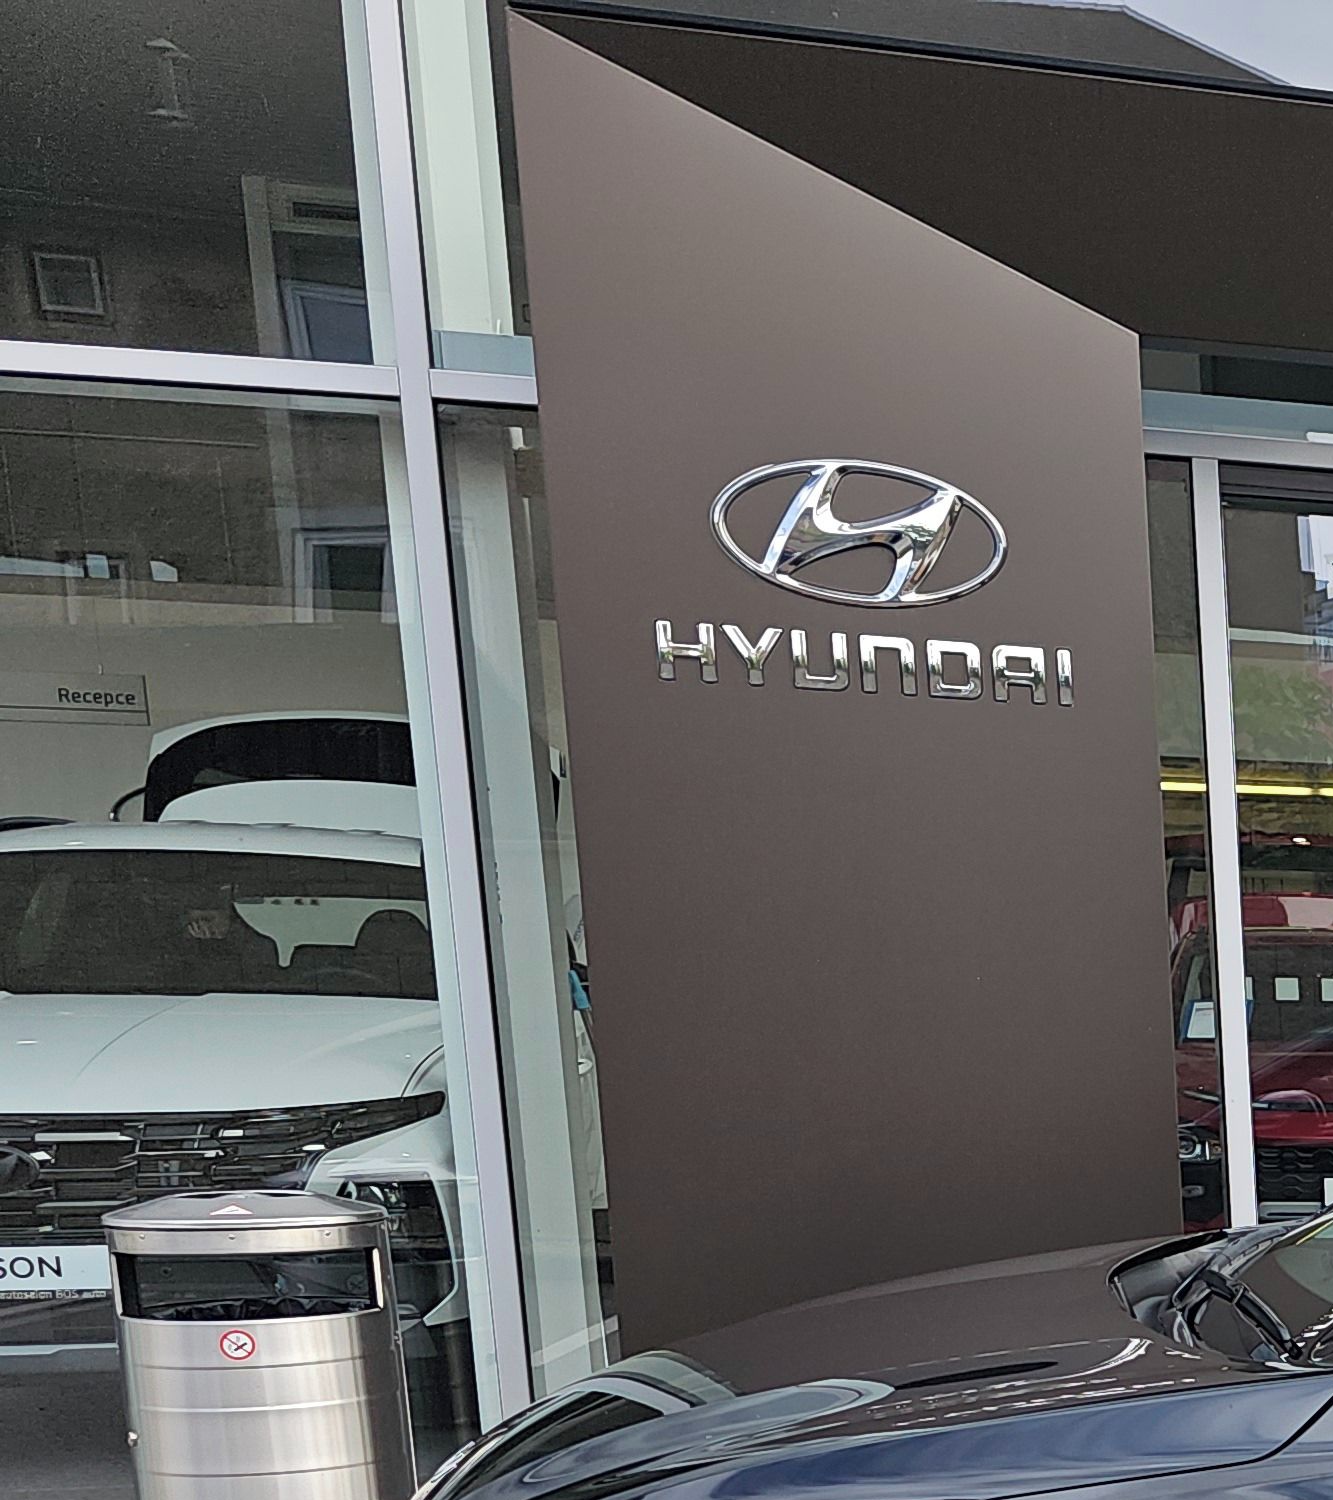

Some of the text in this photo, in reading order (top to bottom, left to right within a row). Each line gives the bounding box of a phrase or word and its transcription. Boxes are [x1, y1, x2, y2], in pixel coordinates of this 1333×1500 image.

[654, 618, 1075, 708] HYUNDAI
[57, 687, 136, 707] Recepce
[56, 1289, 79, 1299] BOS
